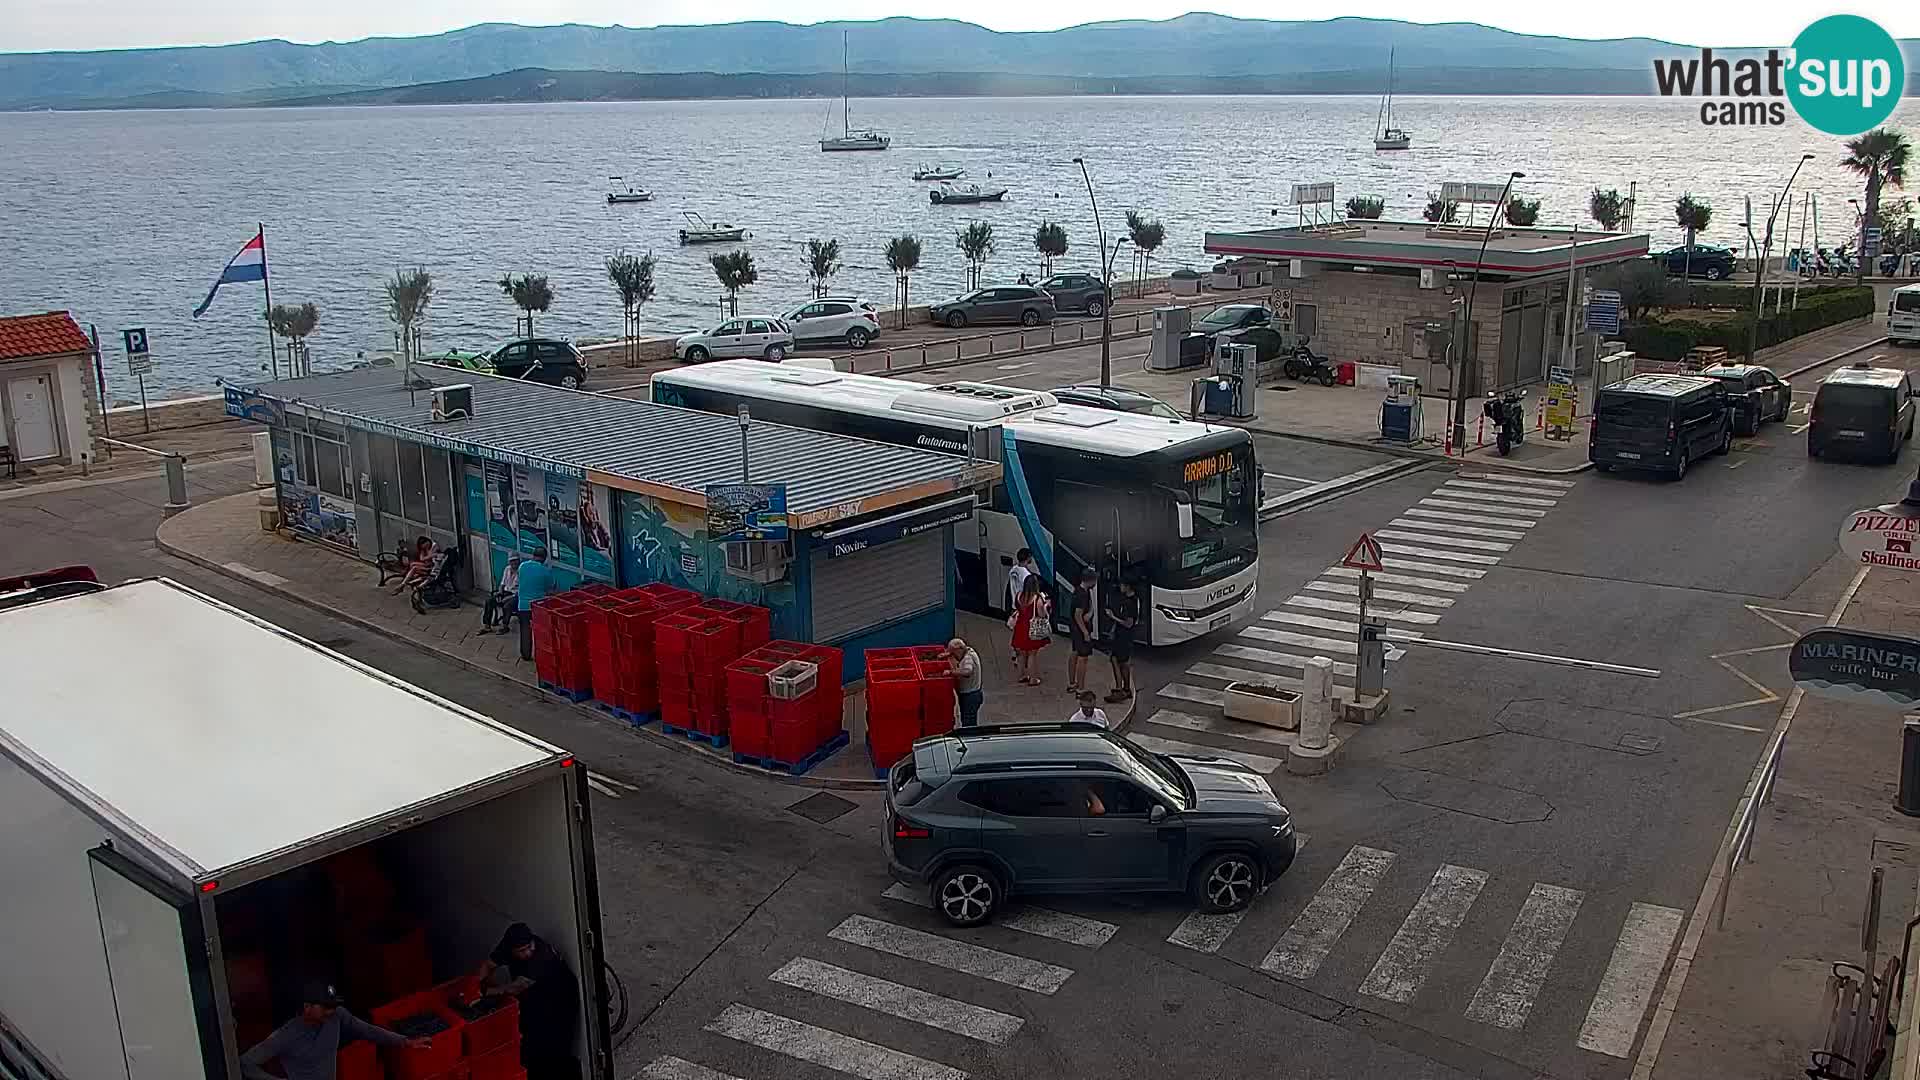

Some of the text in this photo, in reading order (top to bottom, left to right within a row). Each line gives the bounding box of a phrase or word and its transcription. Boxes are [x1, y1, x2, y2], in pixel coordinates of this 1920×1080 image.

[128, 331, 142, 351] P
[437, 439, 468, 452] POSTAJA
[479, 446, 492, 458] BUS
[494, 449, 526, 465] STATION
[528, 458, 553, 473] TICKET
[556, 463, 582, 478] OFFICE
[1184, 455, 1217, 483] ARRIVA
[1849, 516, 1920, 535] PIZZE
[1883, 530, 1918, 543] GRILL
[1206, 583, 1236, 603] IVECO
[1801, 643, 1920, 674] MARINER
[1830, 663, 1899, 681] caffe bar
